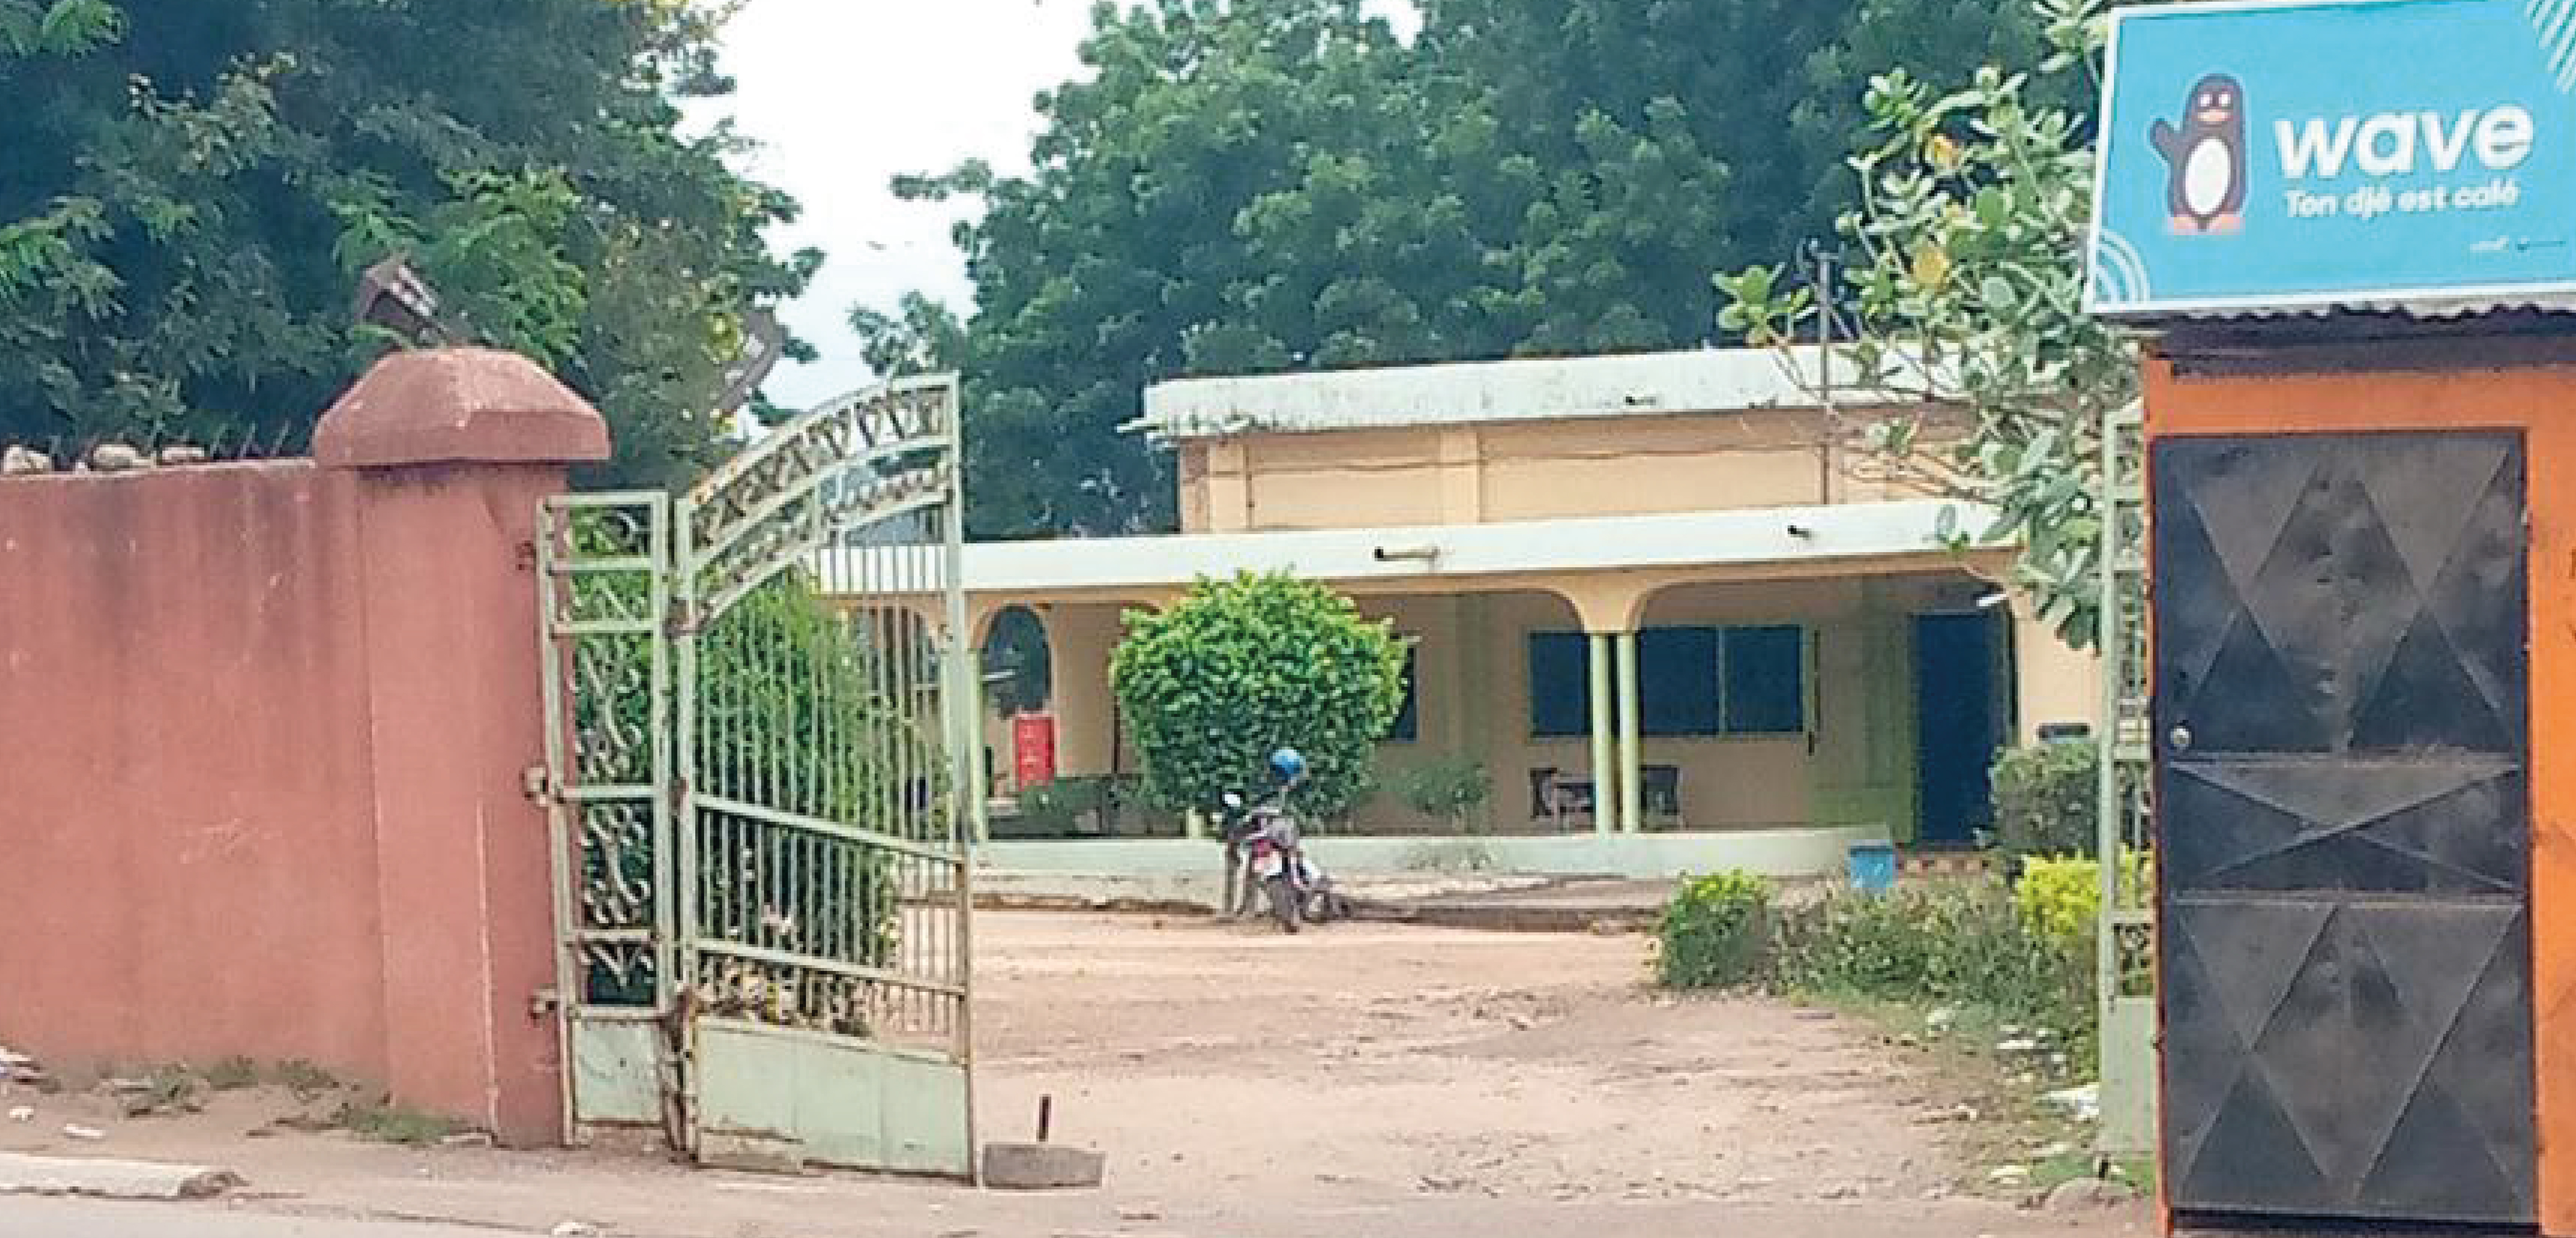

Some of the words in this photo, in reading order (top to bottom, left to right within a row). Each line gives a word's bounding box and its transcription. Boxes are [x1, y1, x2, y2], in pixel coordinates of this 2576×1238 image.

[2274, 105, 2534, 179] wave
[2286, 190, 2337, 218] Ton
[2398, 185, 2446, 211] est
